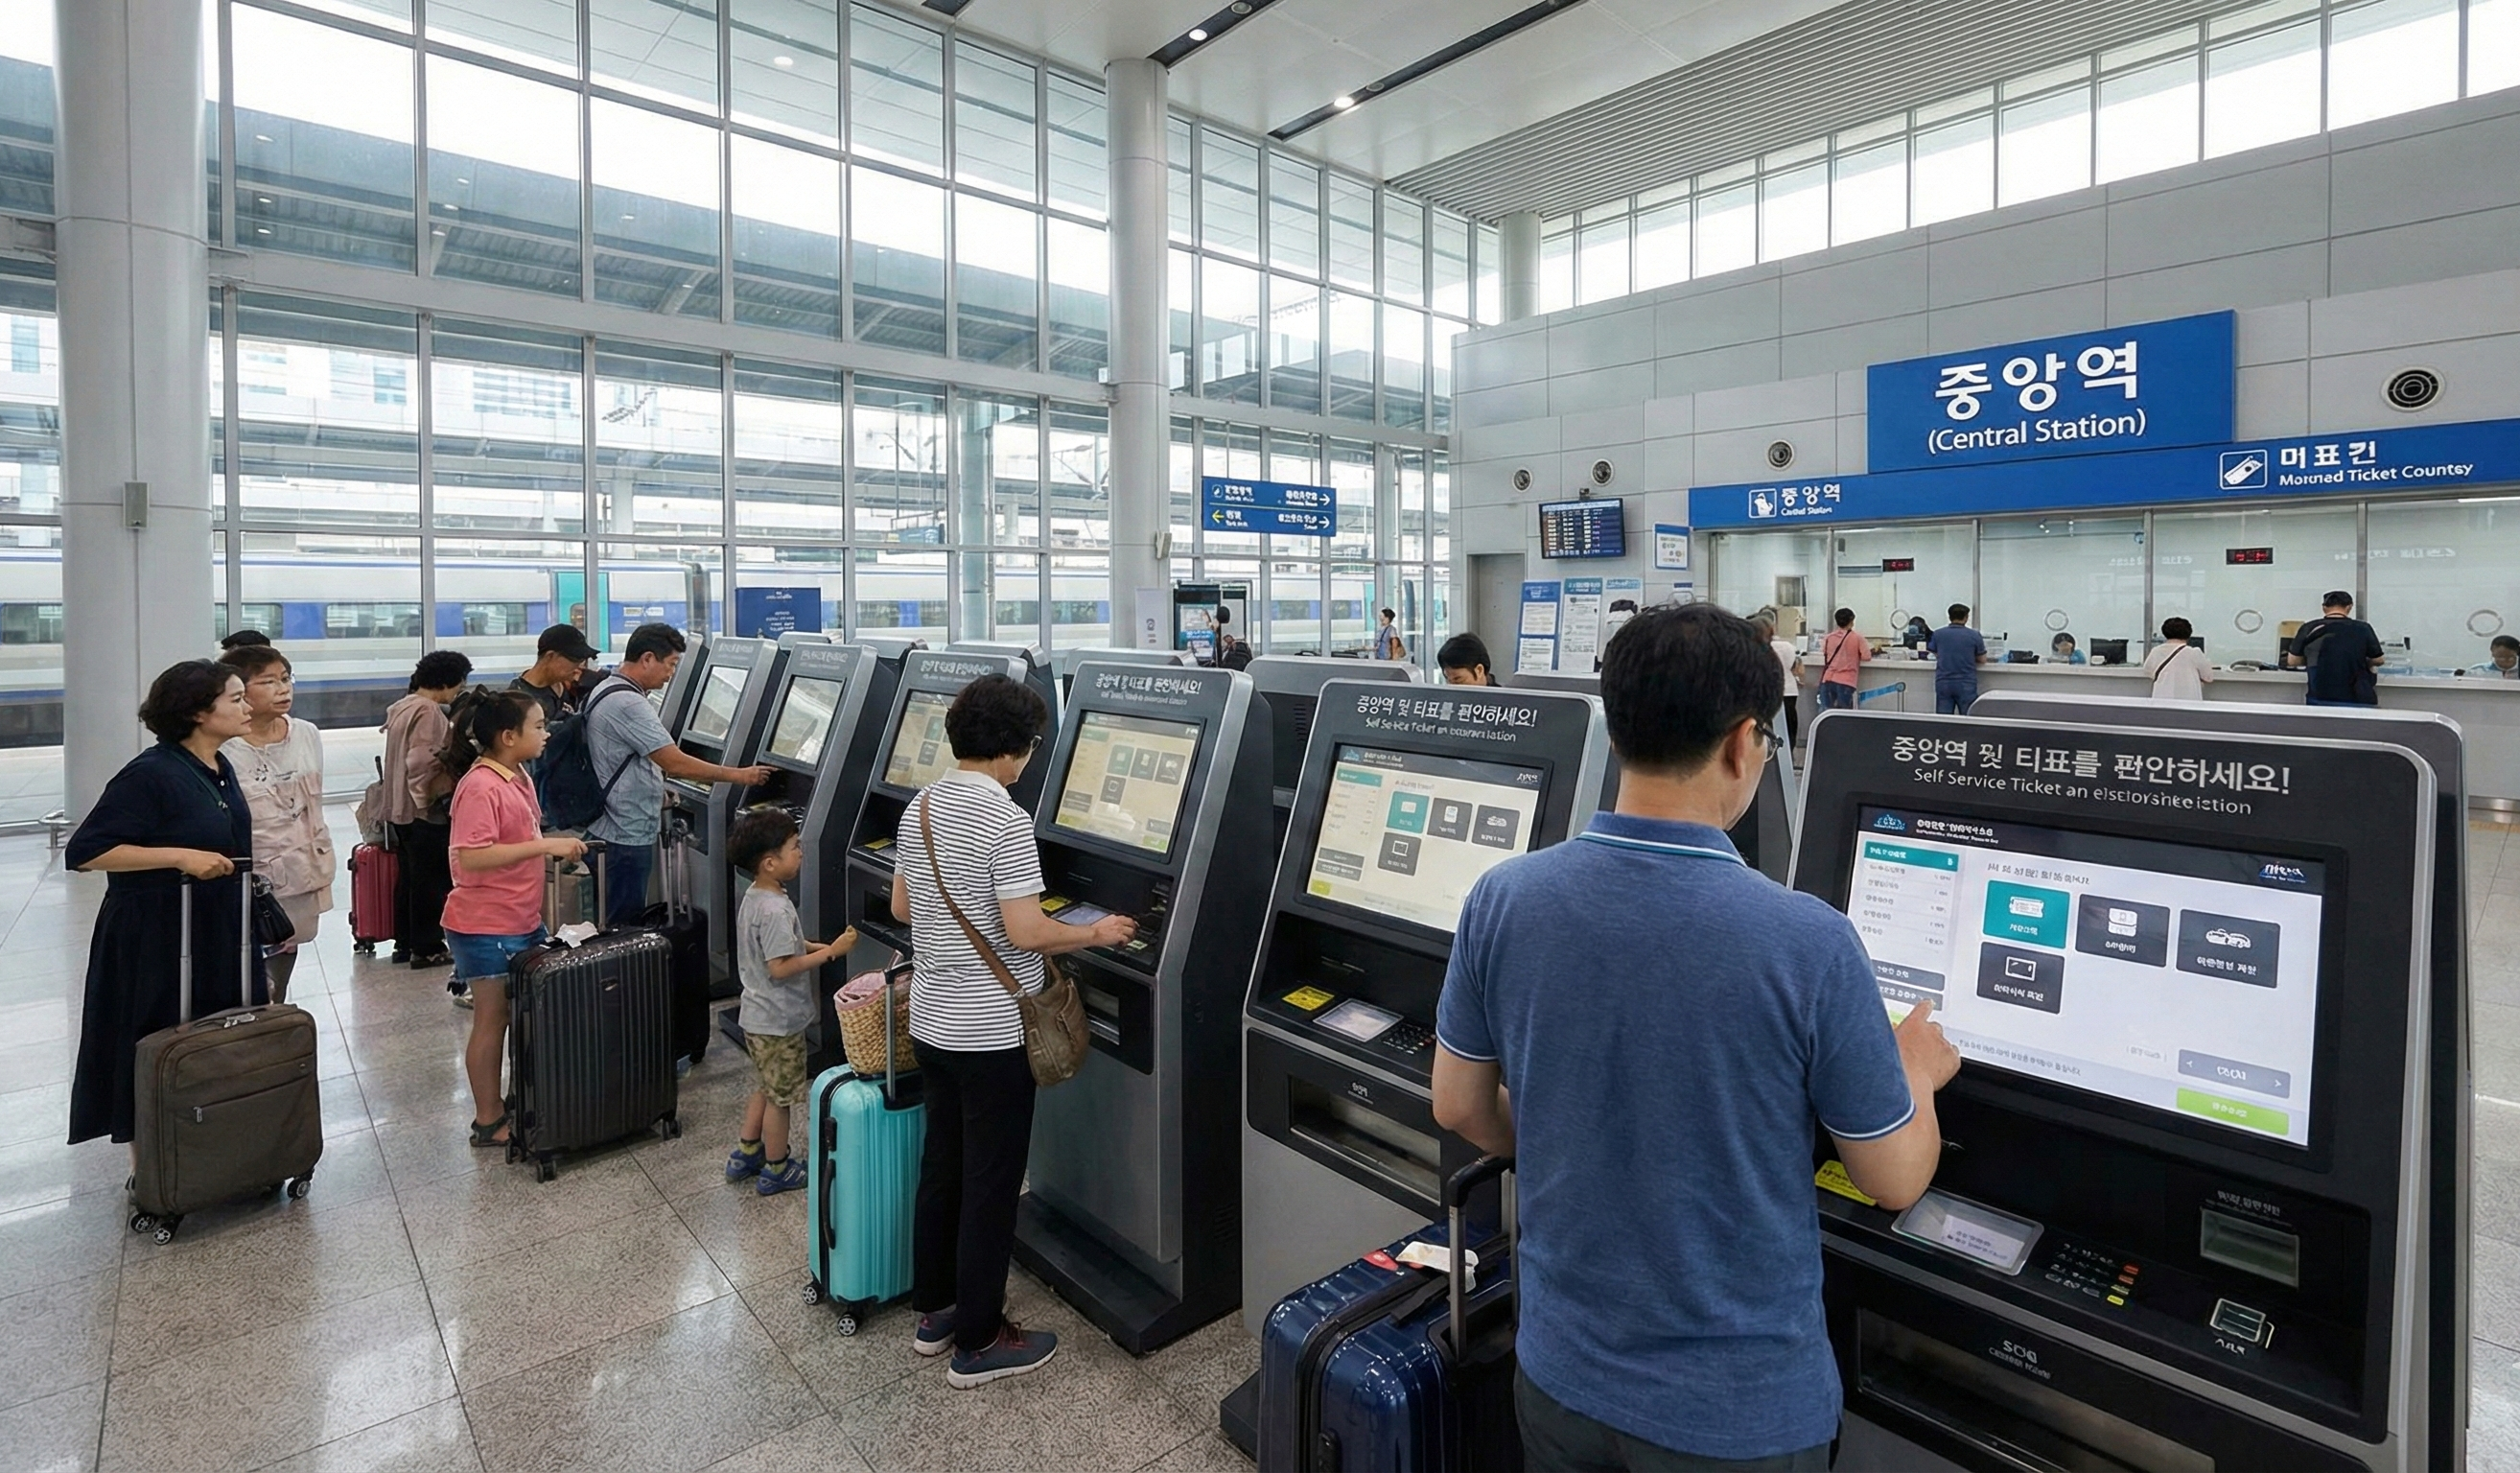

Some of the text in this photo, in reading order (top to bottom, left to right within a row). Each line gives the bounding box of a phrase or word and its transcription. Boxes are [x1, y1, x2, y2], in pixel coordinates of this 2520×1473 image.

[1934, 340, 2137, 421] 중앙역
[1927, 408, 2147, 456] (Central Station)
[2346, 467, 2398, 482] Ticket
[1891, 736, 1968, 767] 중앙역
[2016, 747, 2102, 779] 티표를
[1913, 768, 1945, 783] Self
[1948, 771, 2007, 790] Service
[2010, 777, 2062, 796] Ticket
[2065, 786, 2088, 799] an
